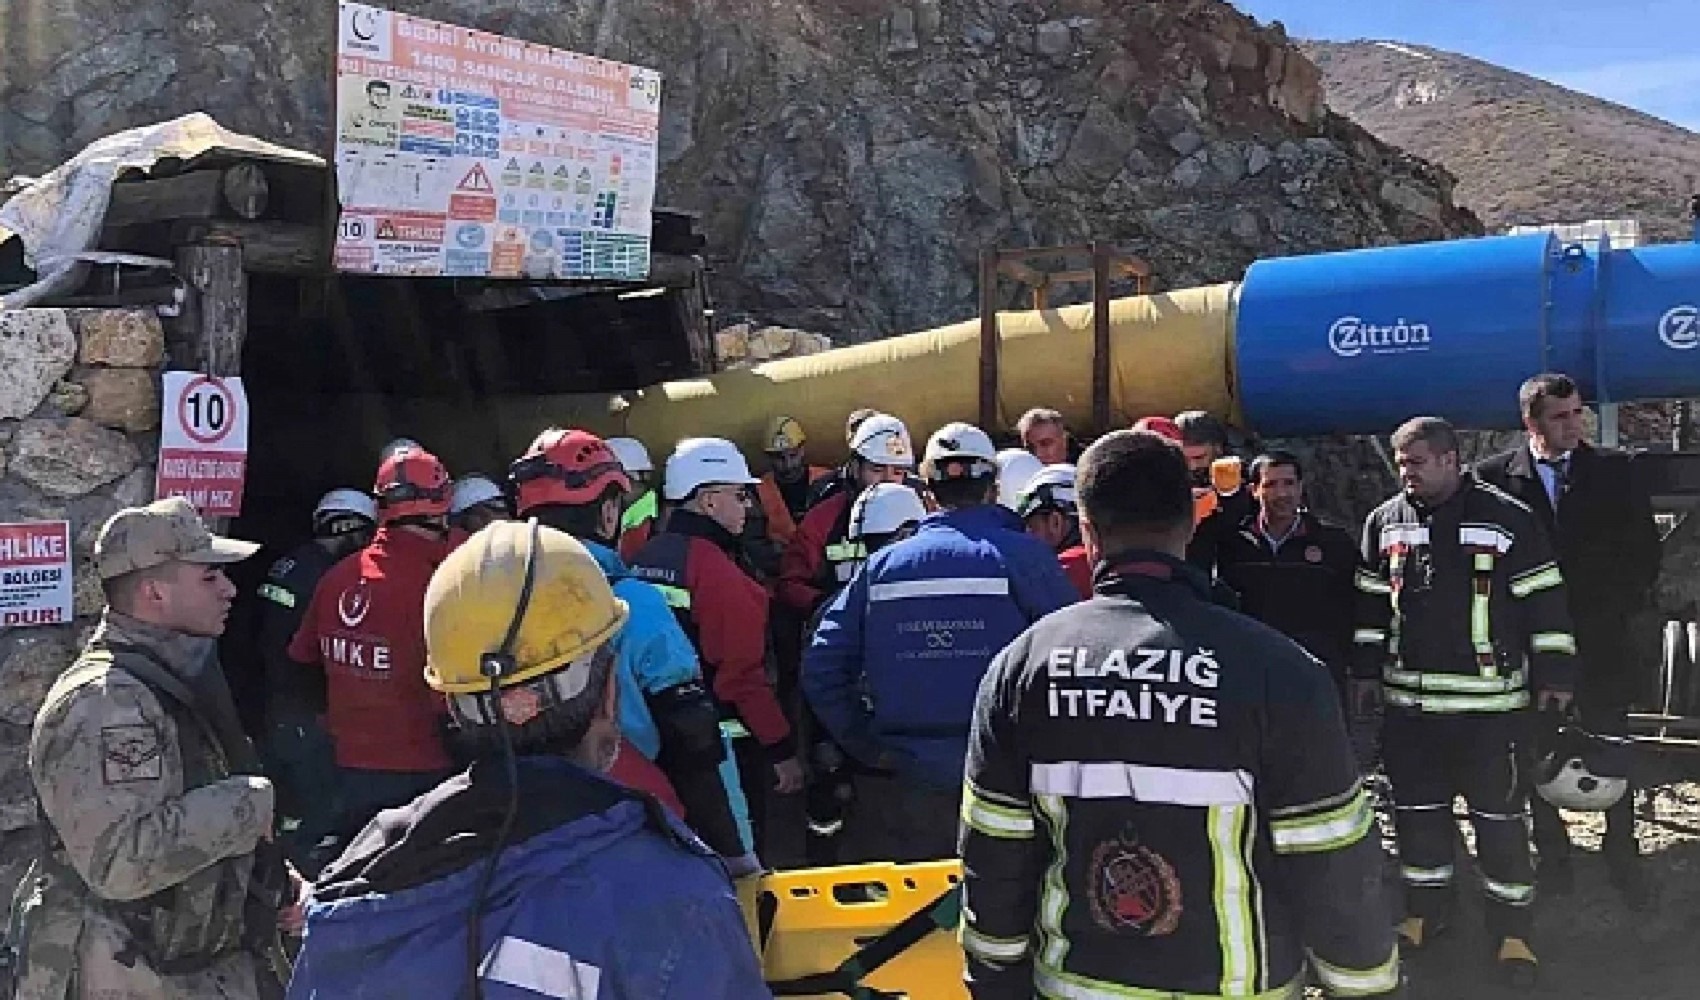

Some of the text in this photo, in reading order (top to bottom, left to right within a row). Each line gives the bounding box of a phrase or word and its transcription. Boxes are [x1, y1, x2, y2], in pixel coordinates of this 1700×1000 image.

[340, 222, 362, 237] 10
[188, 392, 224, 431] 10
[210, 490, 233, 508] HIZ
[4, 607, 62, 624] DUR!
[320, 637, 391, 669] UMKE
[1048, 646, 1220, 688] ELAZIĞ
[1049, 684, 1219, 728] İTFAİYE
